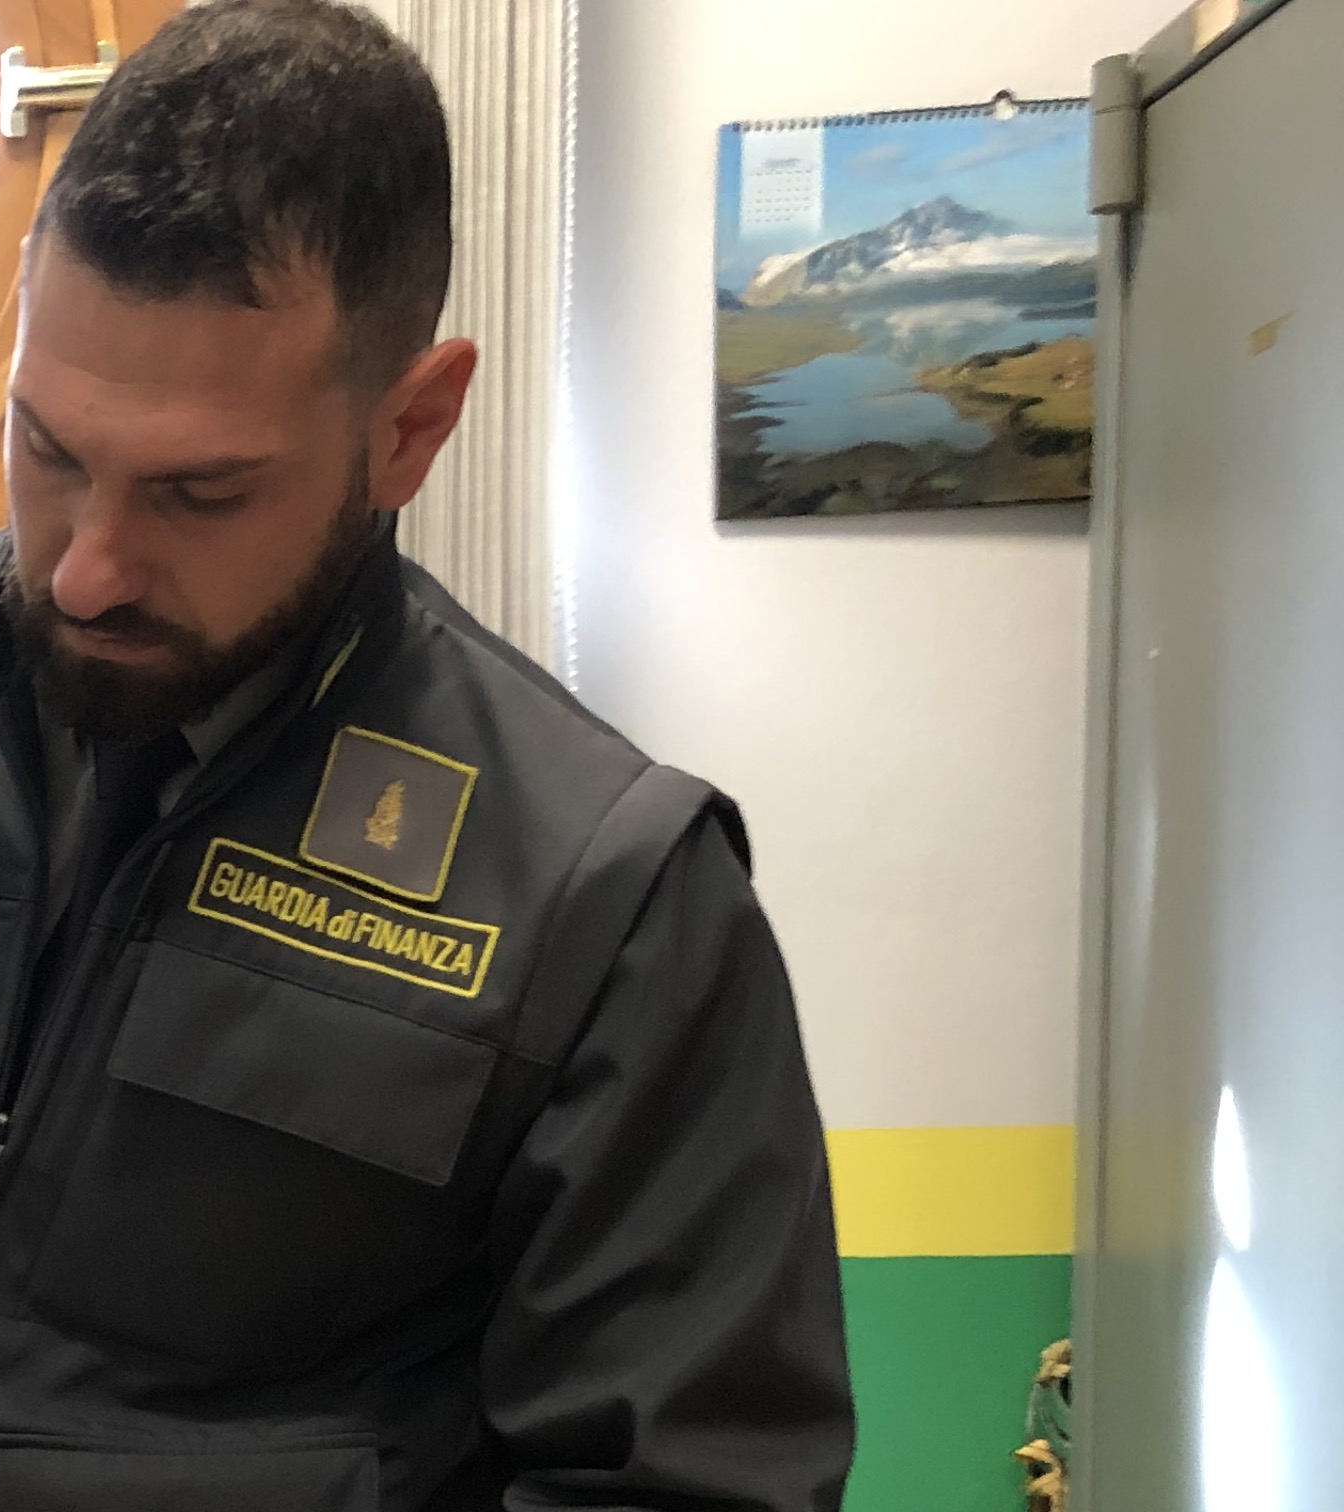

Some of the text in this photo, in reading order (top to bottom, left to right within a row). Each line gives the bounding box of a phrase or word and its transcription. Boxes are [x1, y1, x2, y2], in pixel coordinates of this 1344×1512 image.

[210, 862, 474, 976] GUARDIA di FINANZA
